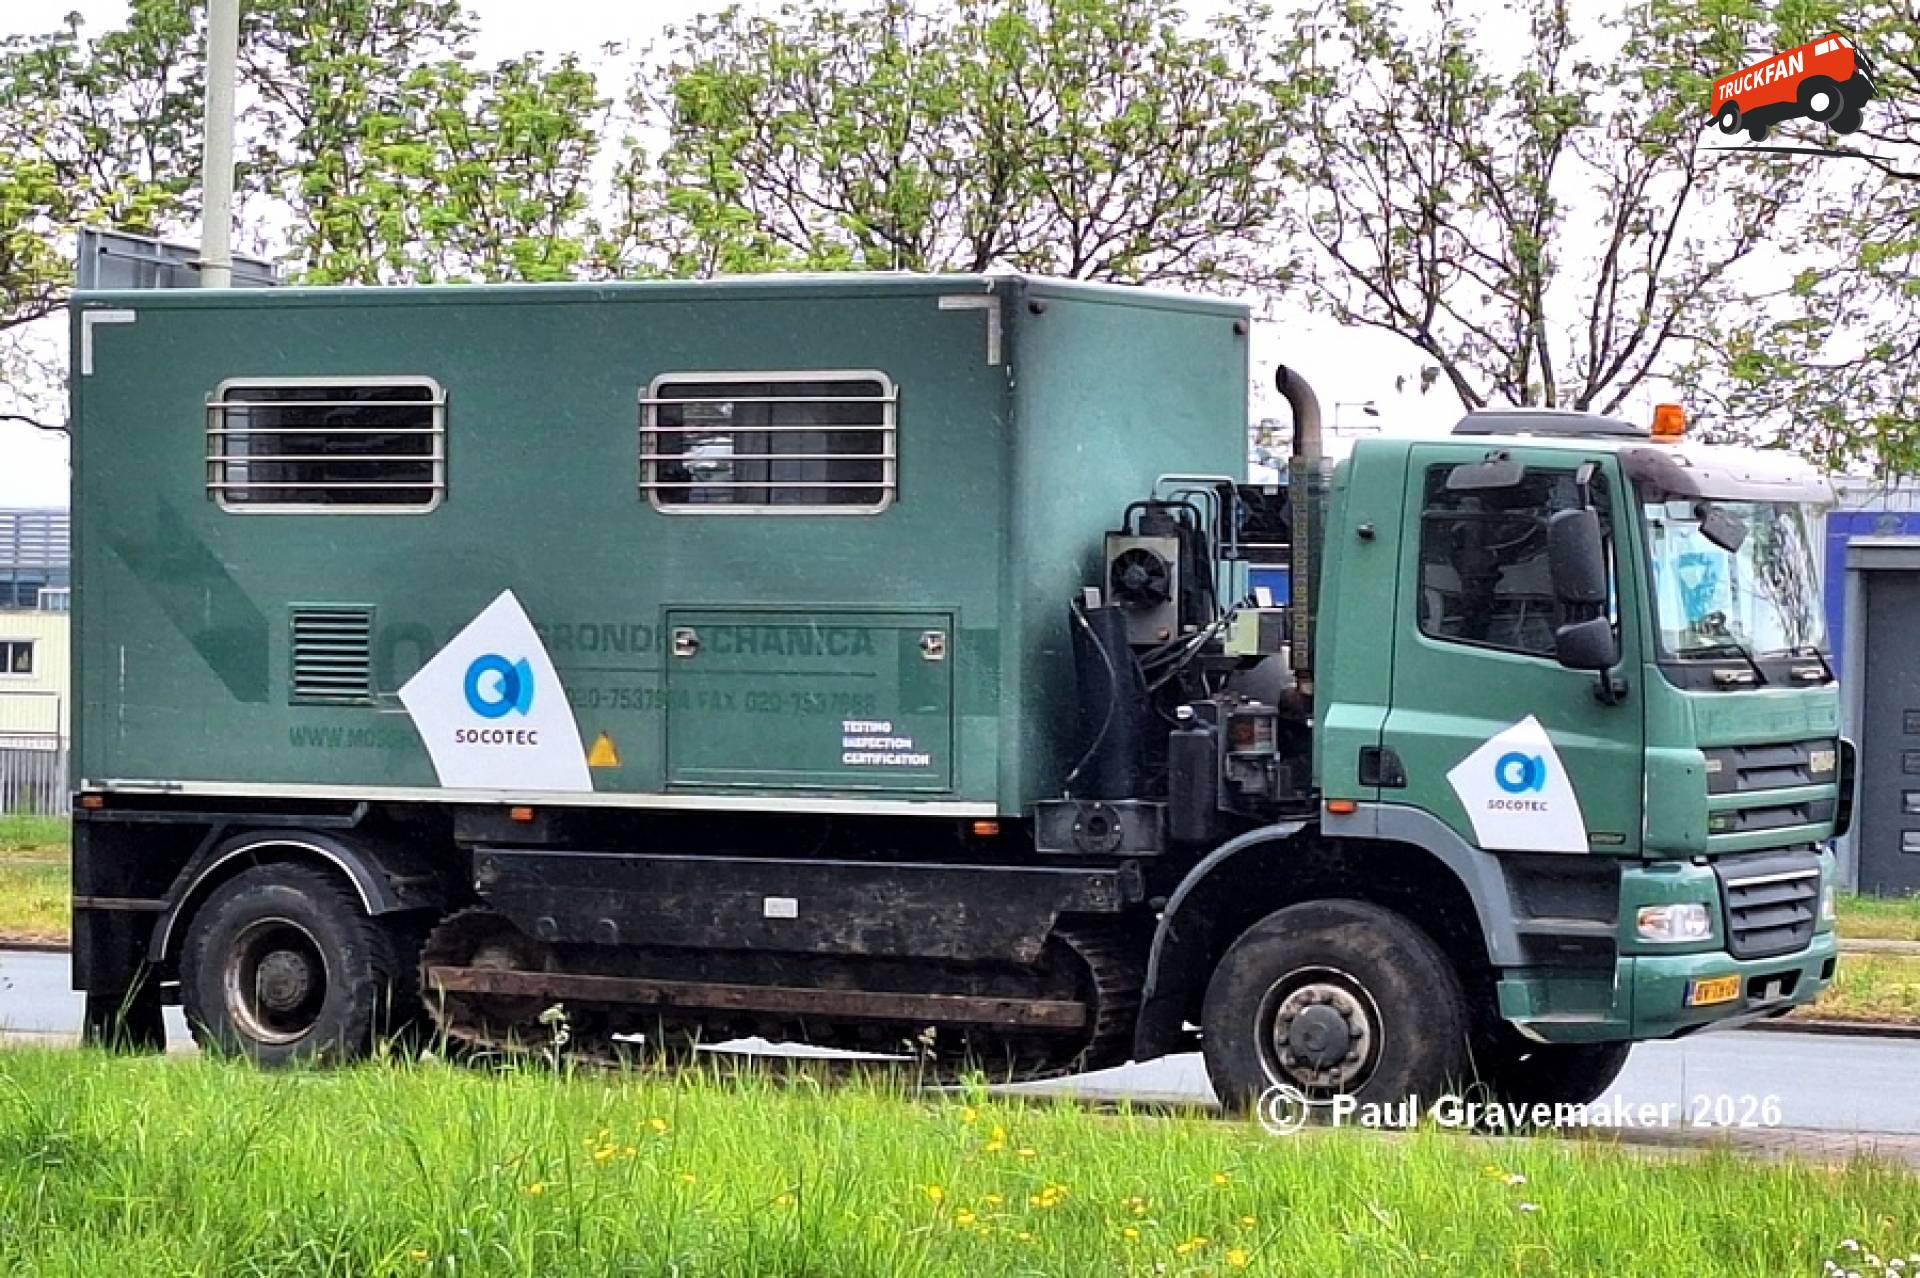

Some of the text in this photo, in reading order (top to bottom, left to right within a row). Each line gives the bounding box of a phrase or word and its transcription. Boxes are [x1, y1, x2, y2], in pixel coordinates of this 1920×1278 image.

[842, 720, 892, 733] TESTING
[455, 729, 538, 745] SOCOTEC
[1488, 799, 1549, 812] SOCOTEC
